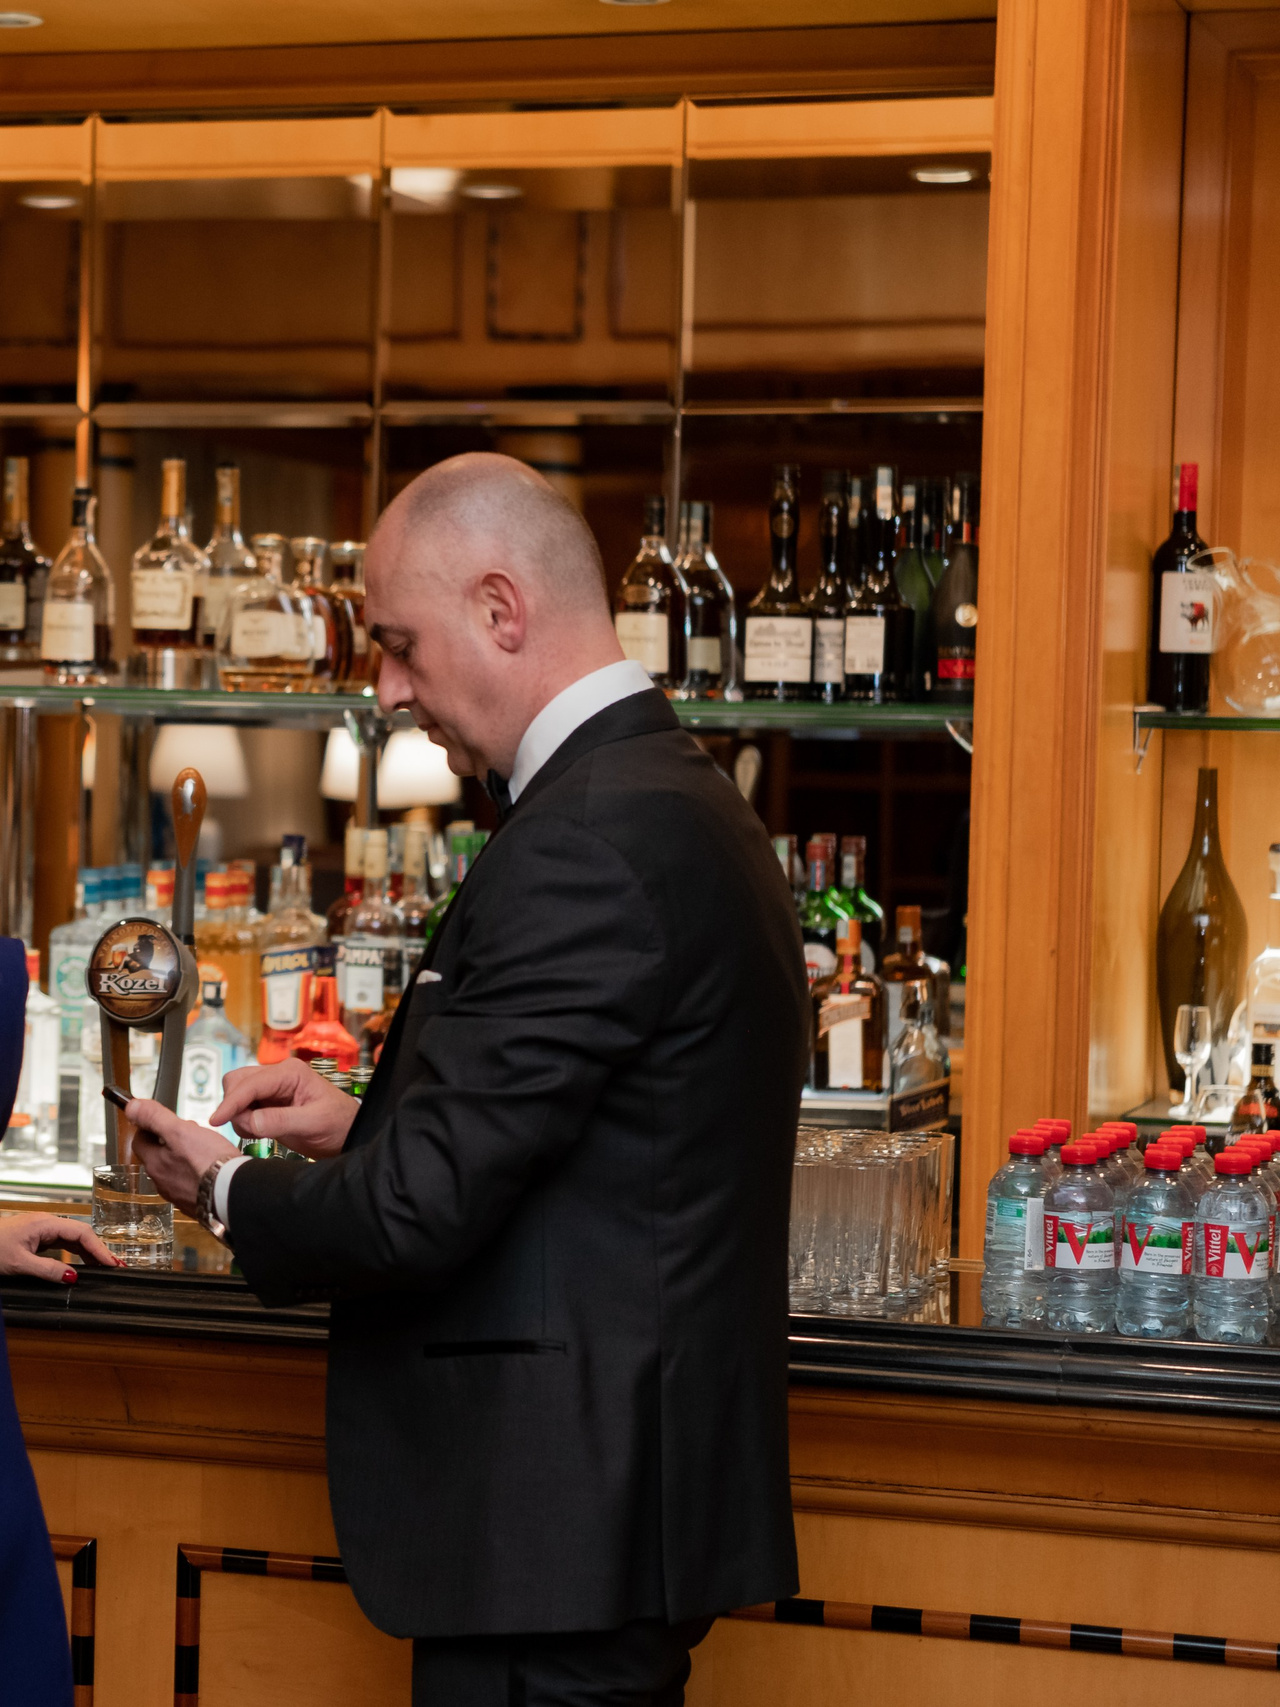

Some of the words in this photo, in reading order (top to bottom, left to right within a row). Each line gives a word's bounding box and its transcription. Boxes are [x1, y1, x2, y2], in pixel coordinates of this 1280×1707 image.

[99, 973, 167, 995] Kozel
[1046, 1219, 1054, 1252] Vittel
[1060, 1222, 1094, 1265] V
[1127, 1222, 1155, 1266] V
[1184, 1227, 1194, 1260] Vittel
[1208, 1229, 1221, 1262] Vittel
[1231, 1232, 1262, 1274] V
